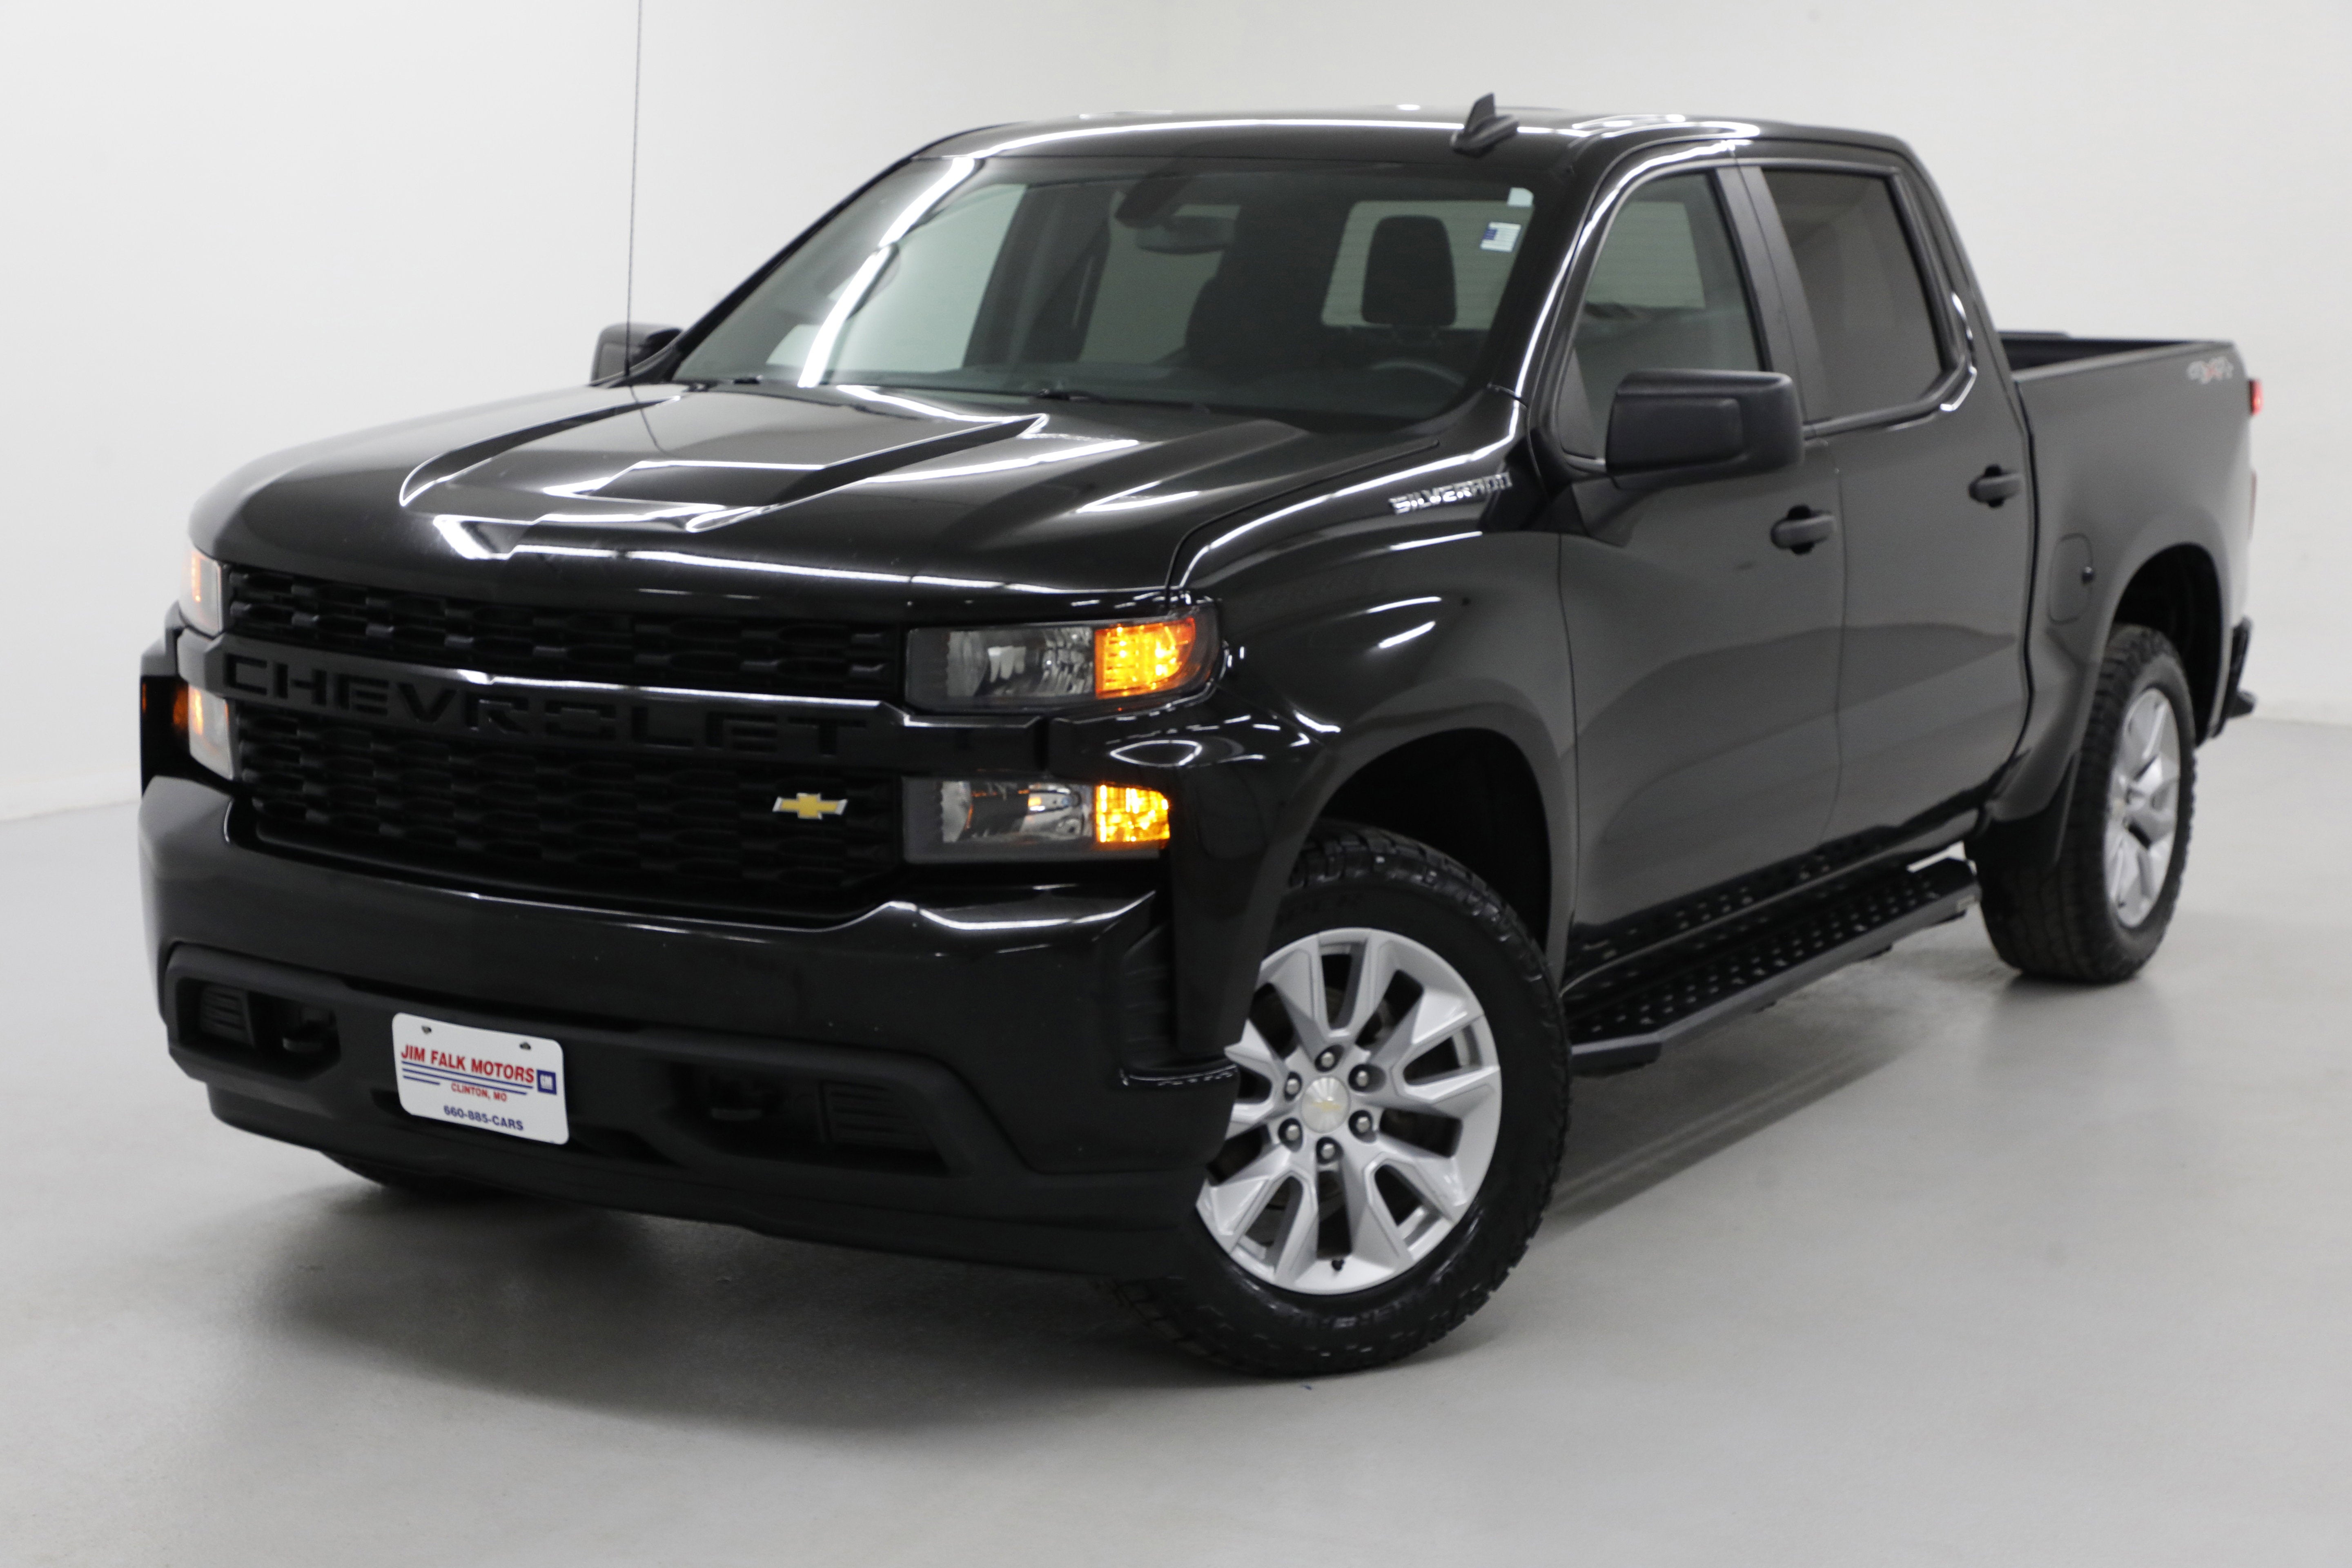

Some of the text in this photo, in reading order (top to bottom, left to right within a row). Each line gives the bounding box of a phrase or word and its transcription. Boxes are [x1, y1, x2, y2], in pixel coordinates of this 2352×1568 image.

[223, 654, 867, 756] CHEVROLET
[401, 1045, 534, 1083] JIM FALK MOTORS
[451, 1083, 507, 1102] CLINTON, MO
[444, 1105, 524, 1131] 660-885-CARS
